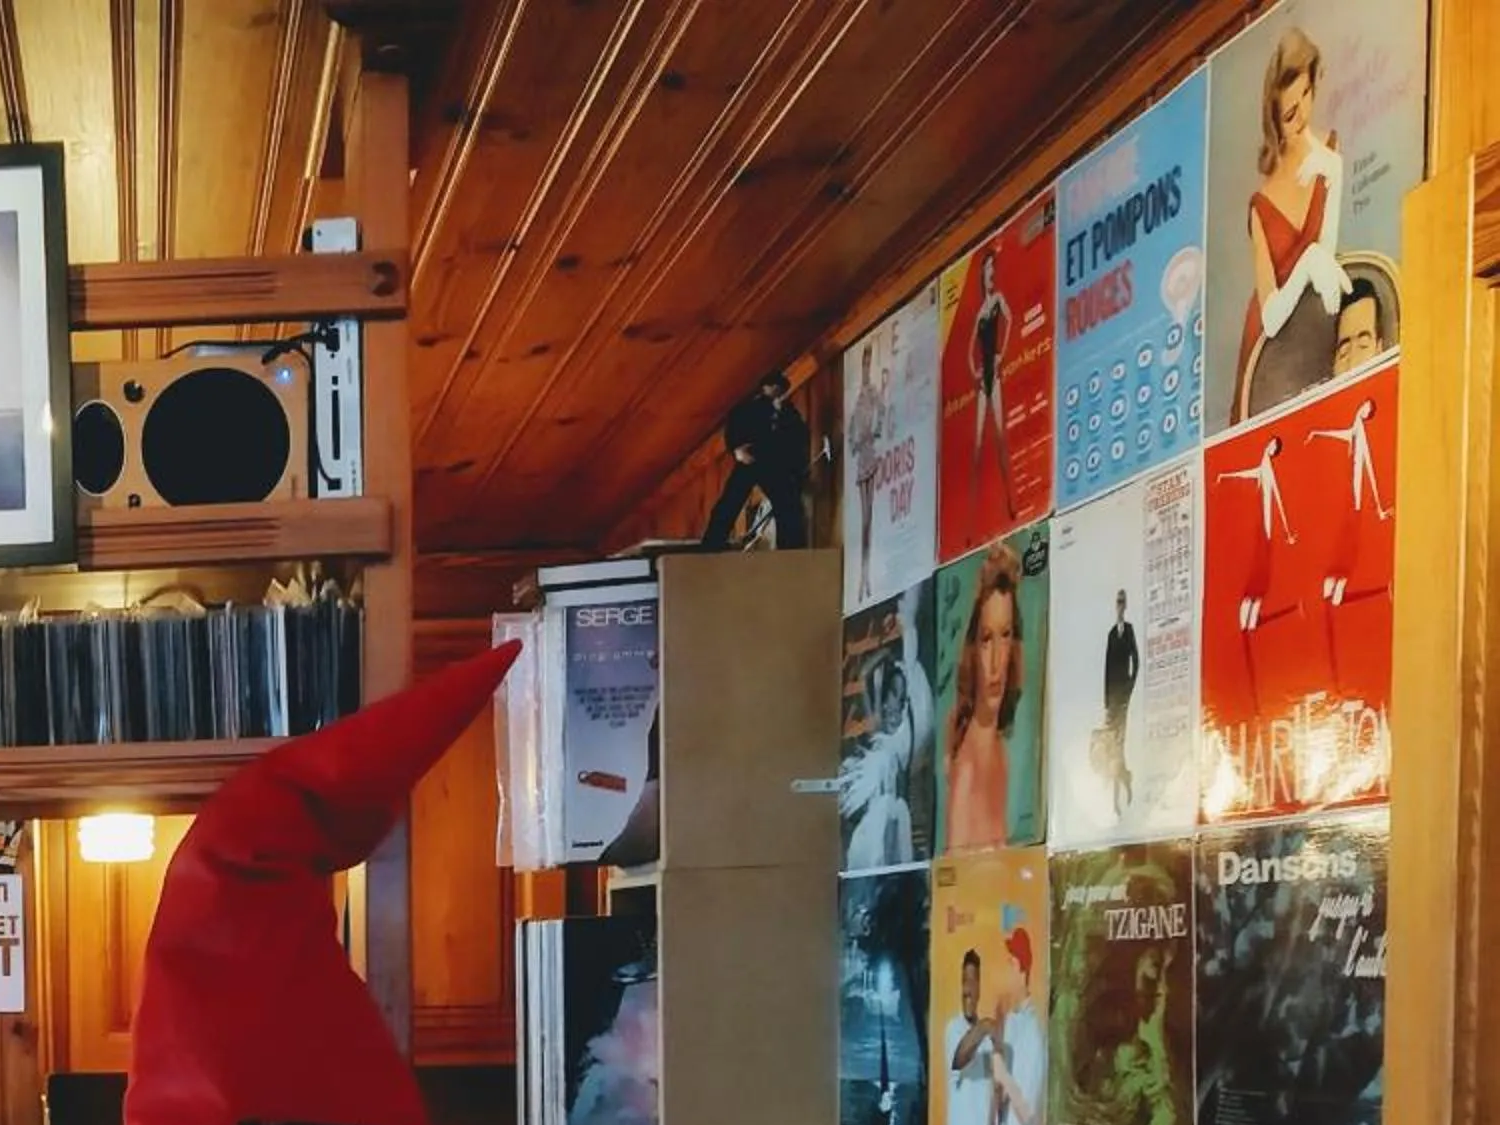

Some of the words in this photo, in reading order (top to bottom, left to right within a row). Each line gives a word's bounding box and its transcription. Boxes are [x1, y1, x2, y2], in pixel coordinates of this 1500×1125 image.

[1066, 230, 1088, 287] ET
[1091, 164, 1183, 271] POMPONS
[1065, 258, 1134, 343] ROUGES
[874, 436, 916, 491] DORIS
[890, 477, 915, 524] DAY
[576, 605, 654, 628] SERGE
[1200, 690, 1391, 815] HARLETON
[1218, 850, 1358, 885] Dansons
[1104, 903, 1188, 941] TZIGANE
